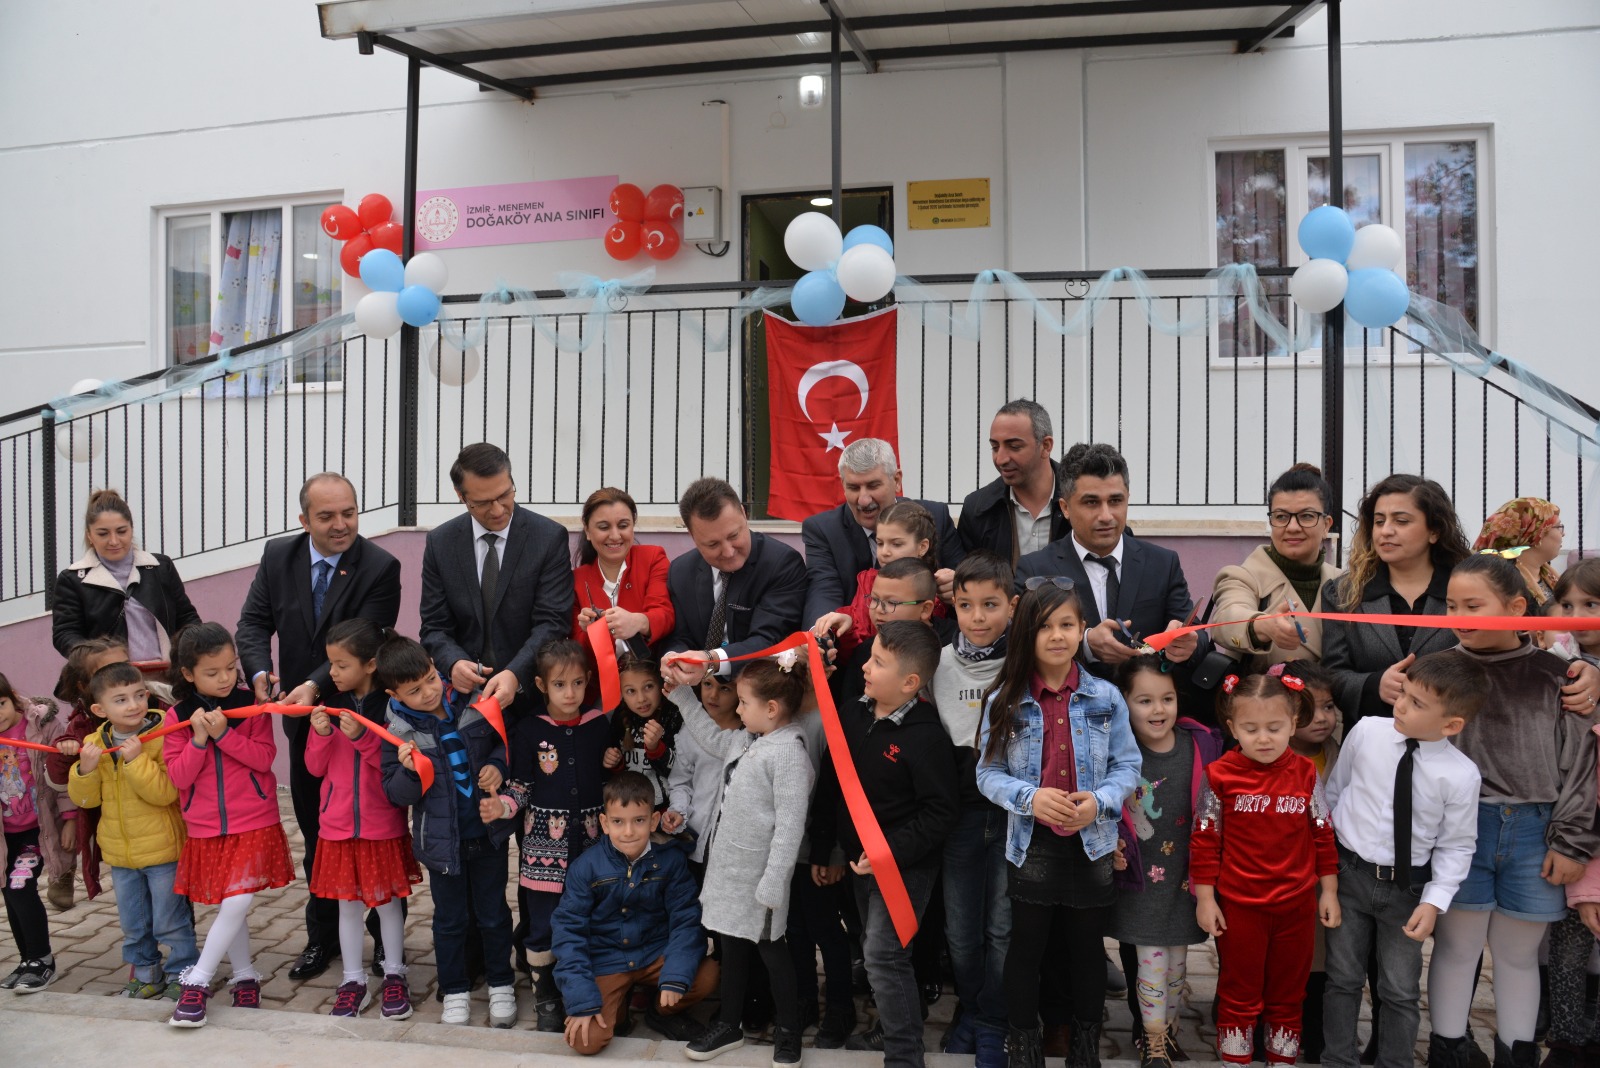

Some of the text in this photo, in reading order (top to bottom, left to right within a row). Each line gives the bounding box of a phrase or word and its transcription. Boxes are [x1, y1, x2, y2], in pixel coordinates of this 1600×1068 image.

[466, 205, 491, 214] İZMİR
[498, 202, 544, 212] MENEMEN
[466, 208, 605, 228] DOĞAKÖY ANA SINIFI
[959, 689, 986, 701] STRO
